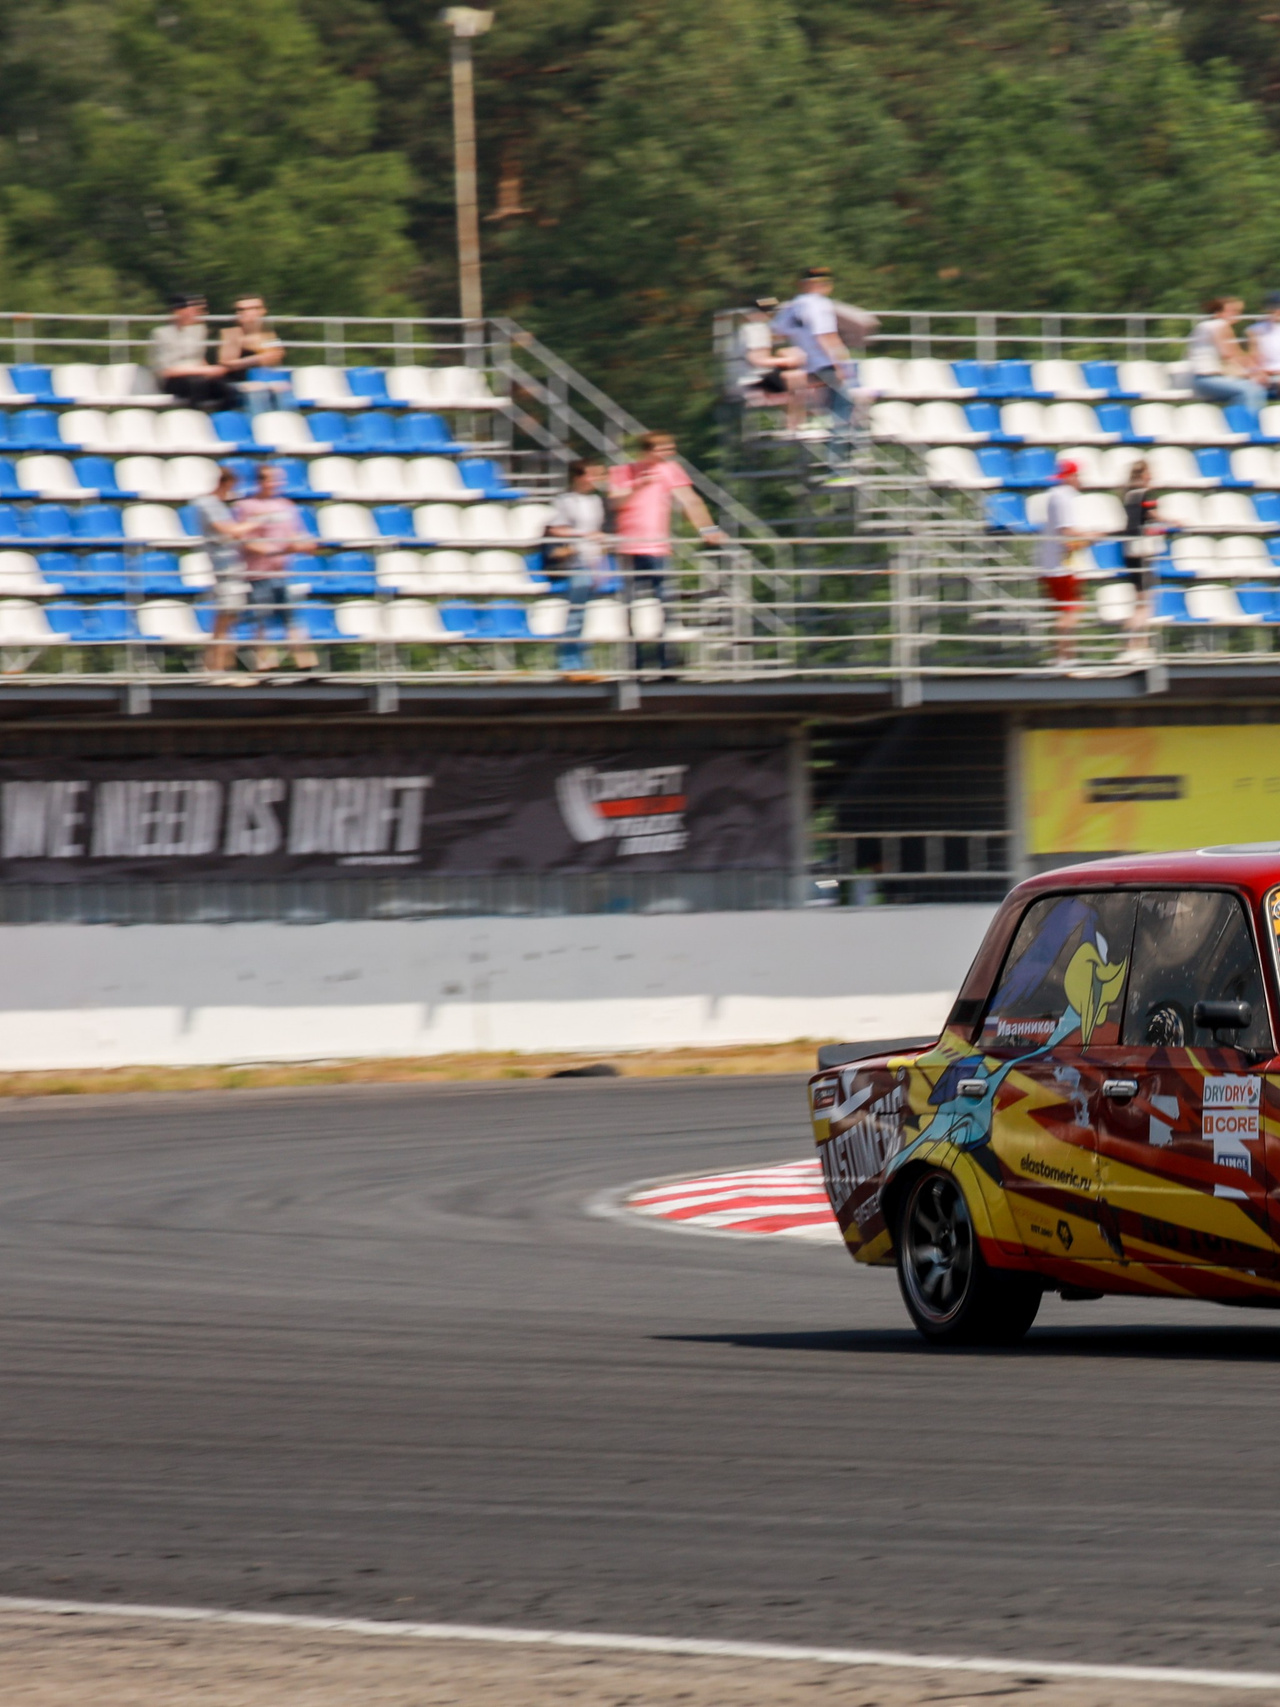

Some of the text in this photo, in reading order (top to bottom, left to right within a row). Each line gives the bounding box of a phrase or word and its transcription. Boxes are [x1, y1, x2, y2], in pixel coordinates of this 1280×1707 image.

[90, 780, 224, 857] NEED
[287, 776, 433, 854] DRIFT
[997, 1020, 1056, 1037] Иванников
[1204, 1085, 1246, 1103] DRYDRY
[1020, 1152, 1092, 1191] elastomeric.ru
